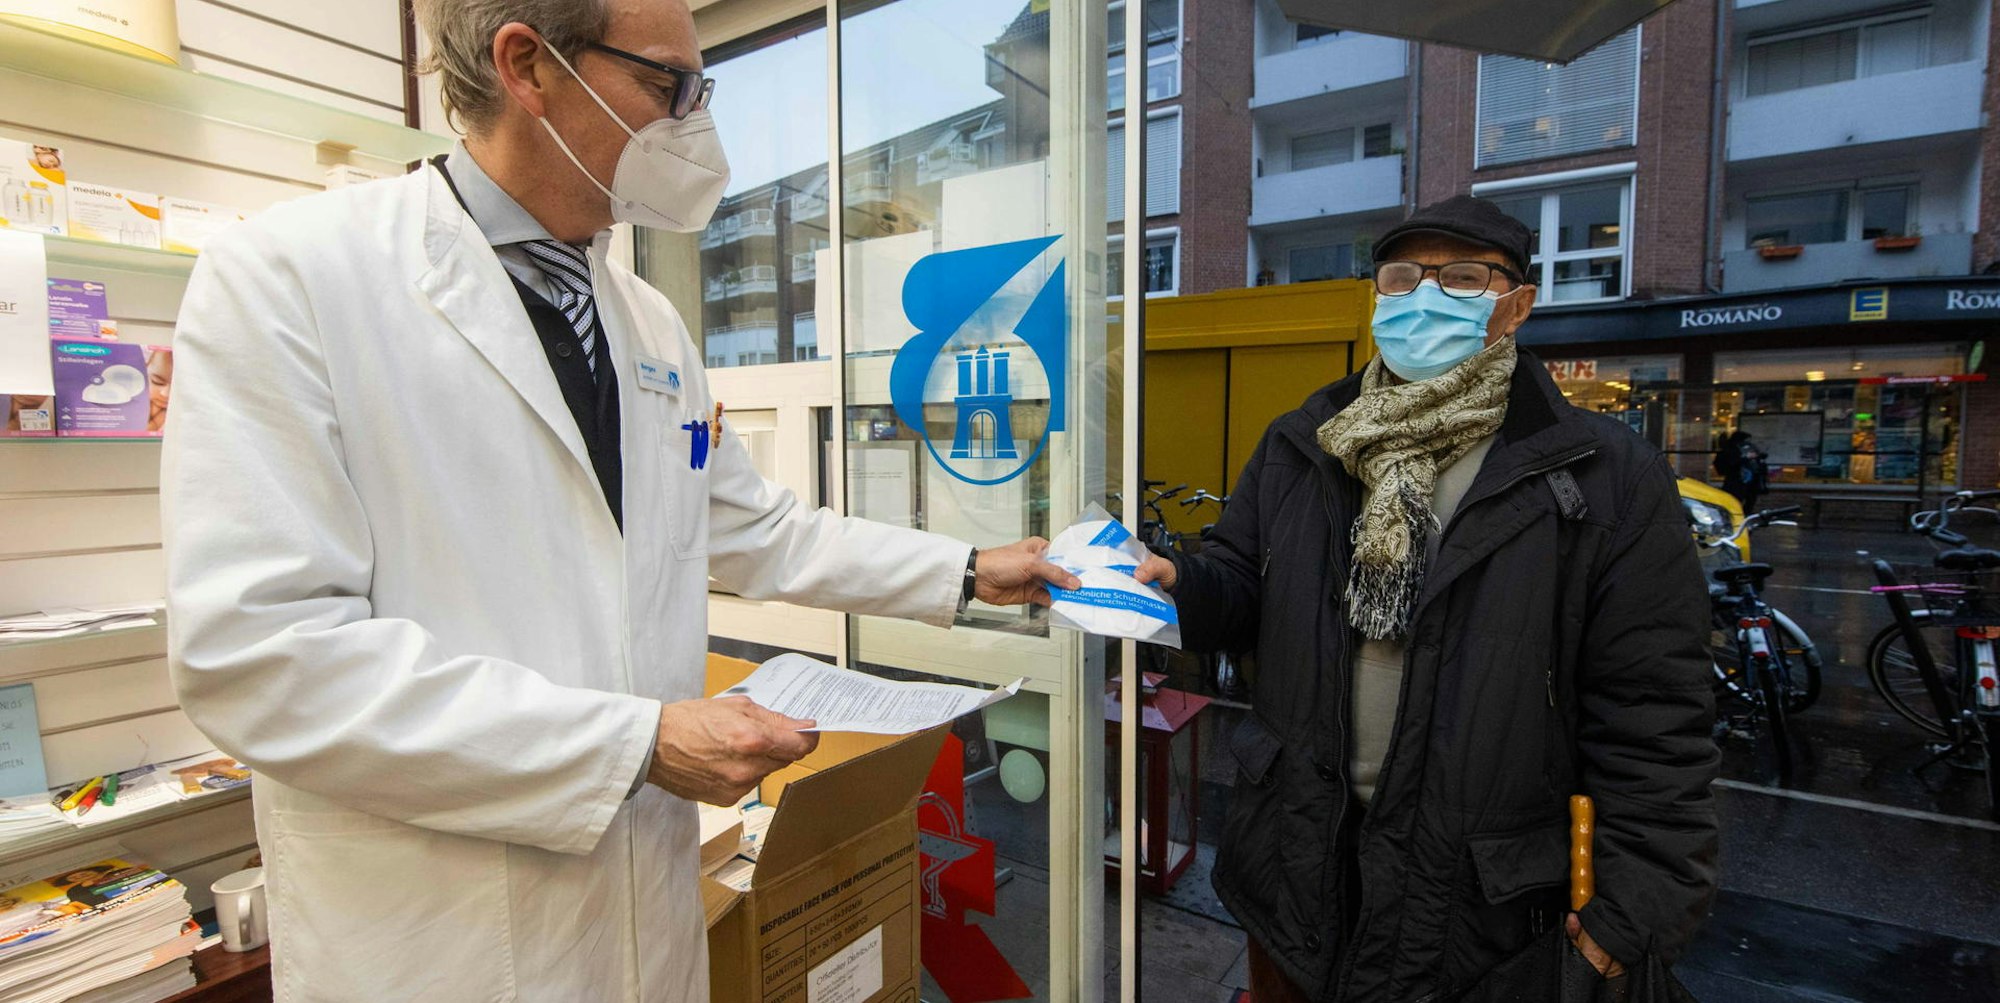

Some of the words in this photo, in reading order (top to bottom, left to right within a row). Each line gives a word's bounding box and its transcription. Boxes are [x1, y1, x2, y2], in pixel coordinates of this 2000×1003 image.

[78, 5, 117, 22] medela
[73, 186, 112, 197] medela
[1680, 306, 1782, 328] ROMANO
[1094, 598, 1127, 607] PROTECTIVE
[1113, 592, 1167, 613] Schutzmaske
[760, 904, 803, 936] DISPOSABLE
[804, 895, 820, 911] FACE
[821, 884, 840, 902] MASK
[840, 877, 853, 892] FOR
[852, 860, 882, 884] PERSONAL
